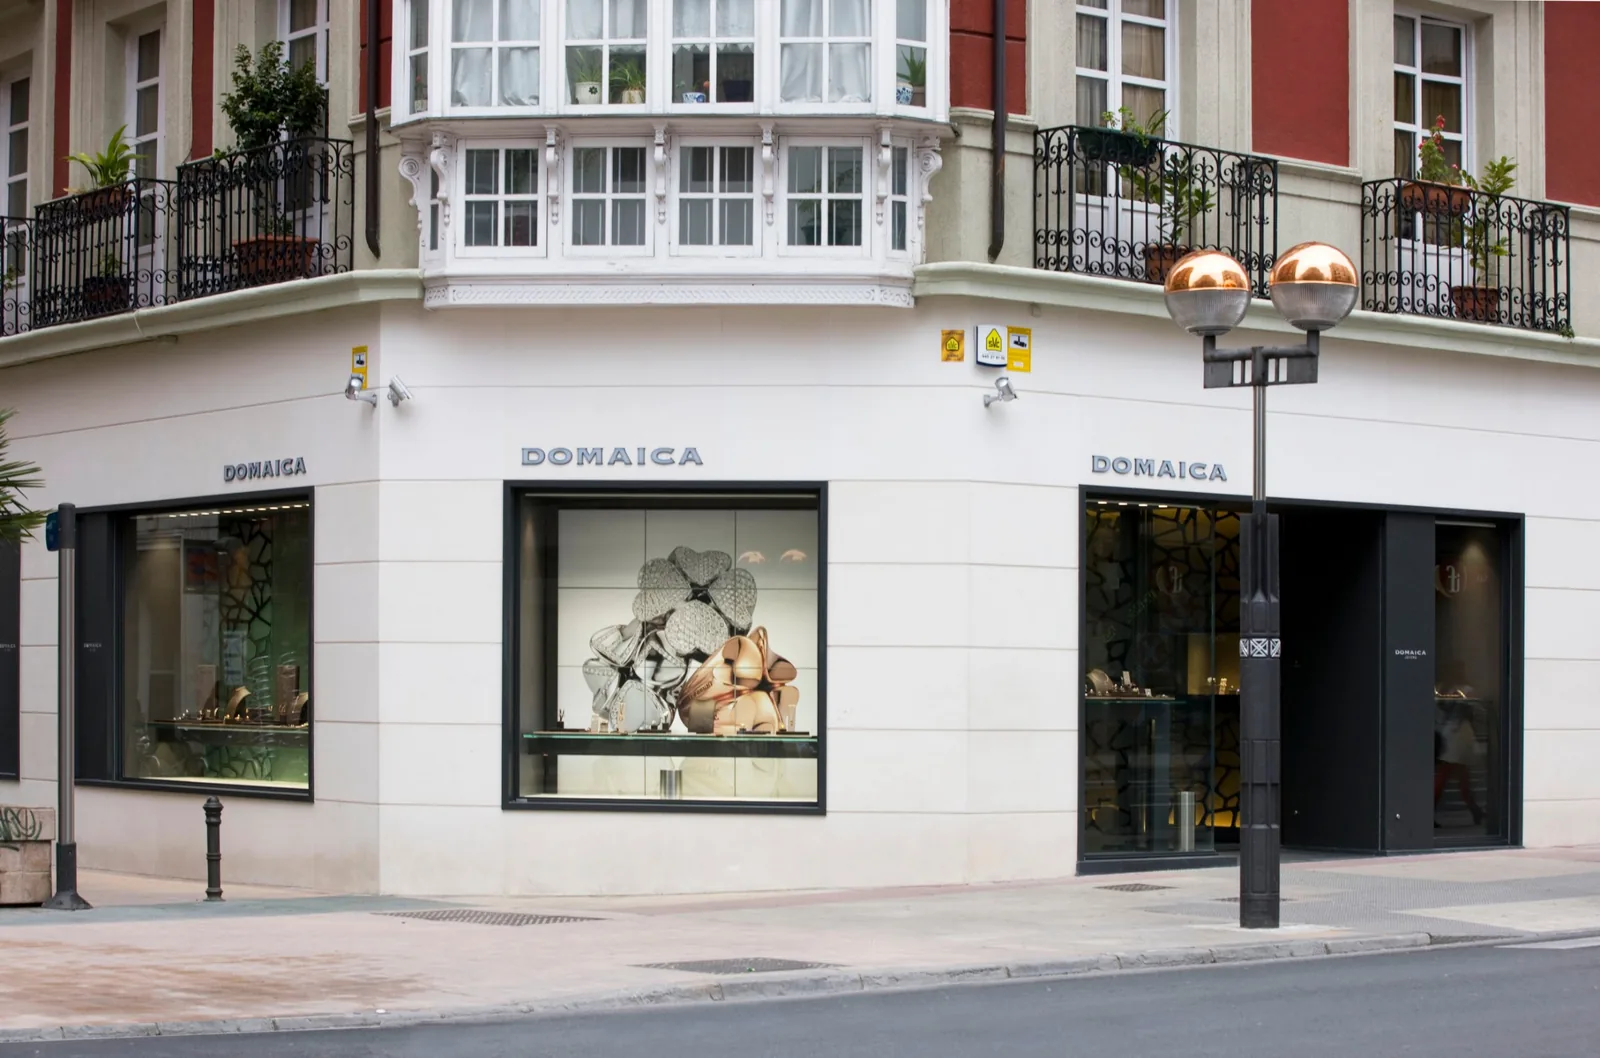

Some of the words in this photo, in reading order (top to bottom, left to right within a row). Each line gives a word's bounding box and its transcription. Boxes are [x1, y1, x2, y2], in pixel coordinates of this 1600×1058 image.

[223, 456, 307, 483] DOMAICA
[521, 447, 703, 466] DOMAICA
[1091, 454, 1228, 482] DOMAICA
